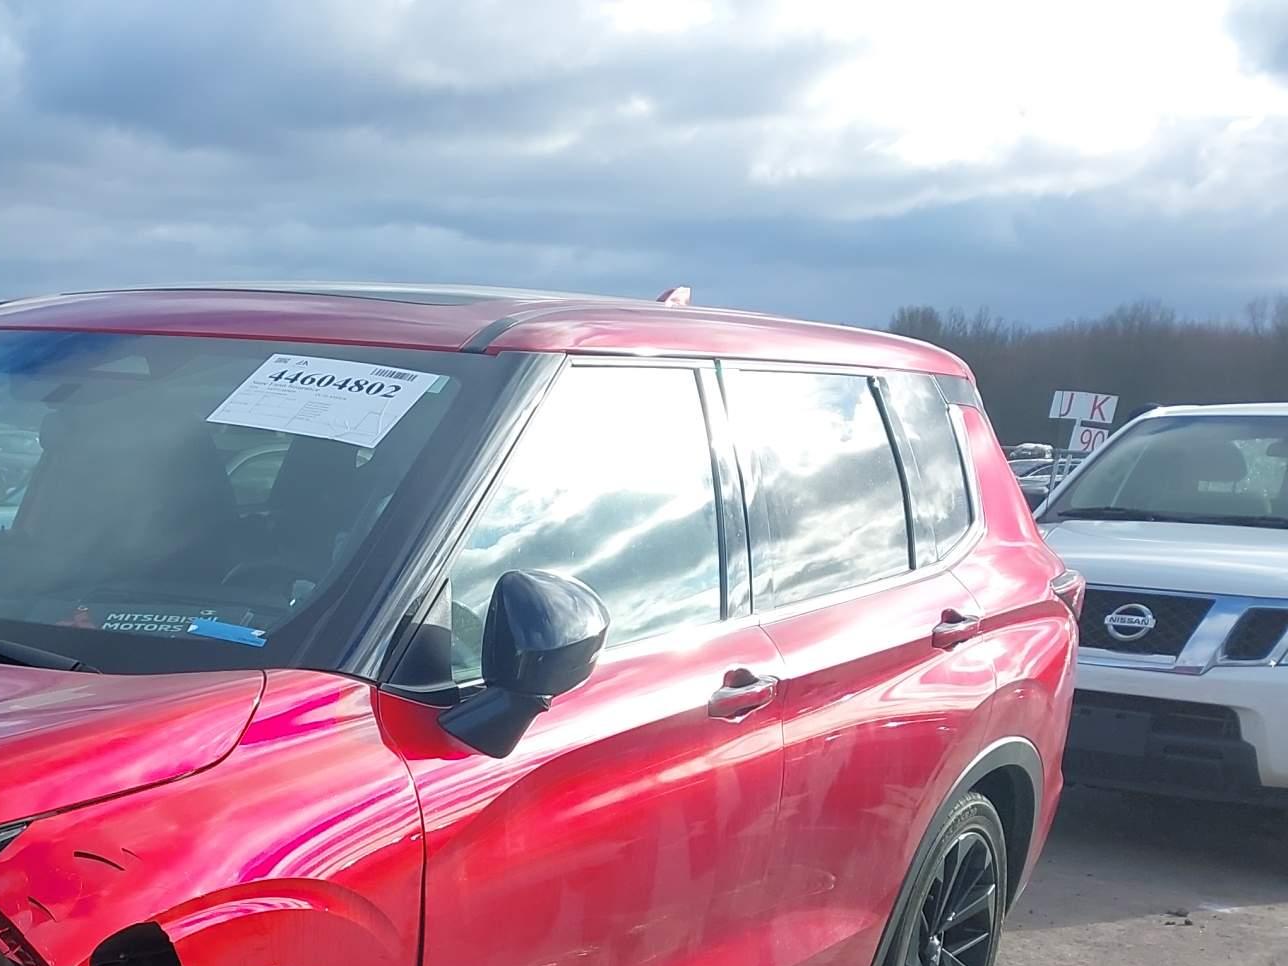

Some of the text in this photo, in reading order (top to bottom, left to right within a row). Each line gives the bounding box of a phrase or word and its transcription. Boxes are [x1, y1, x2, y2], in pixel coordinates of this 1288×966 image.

[268, 369, 402, 398] 44604802
[1059, 392, 1111, 421] J K
[101, 622, 184, 633] MOTORS
[1109, 616, 1150, 626] NISSAN
